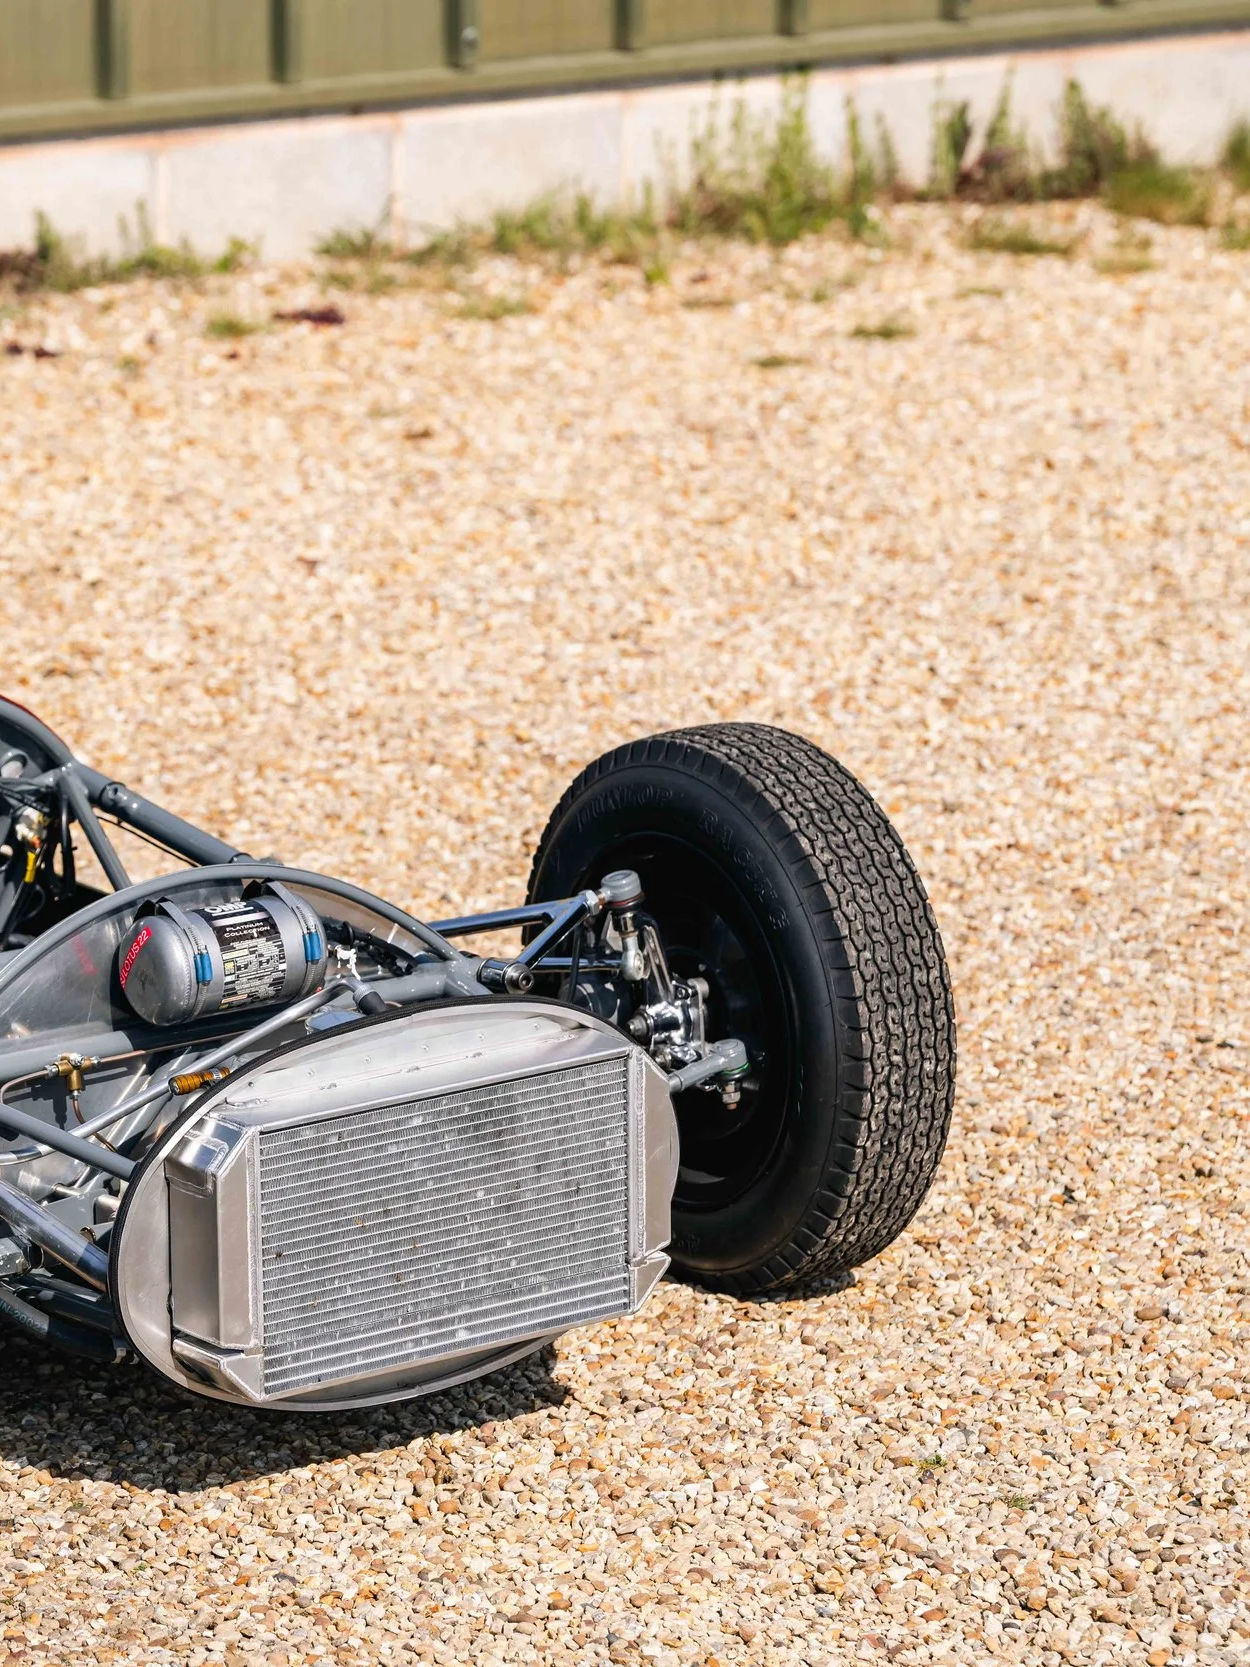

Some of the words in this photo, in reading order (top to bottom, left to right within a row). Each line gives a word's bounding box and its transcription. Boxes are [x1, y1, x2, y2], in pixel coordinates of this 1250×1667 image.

[204, 901, 248, 914] OMP
[225, 921, 264, 932] PLATINUM
[121, 942, 140, 978] LOTUS
[137, 930, 149, 946] 22
